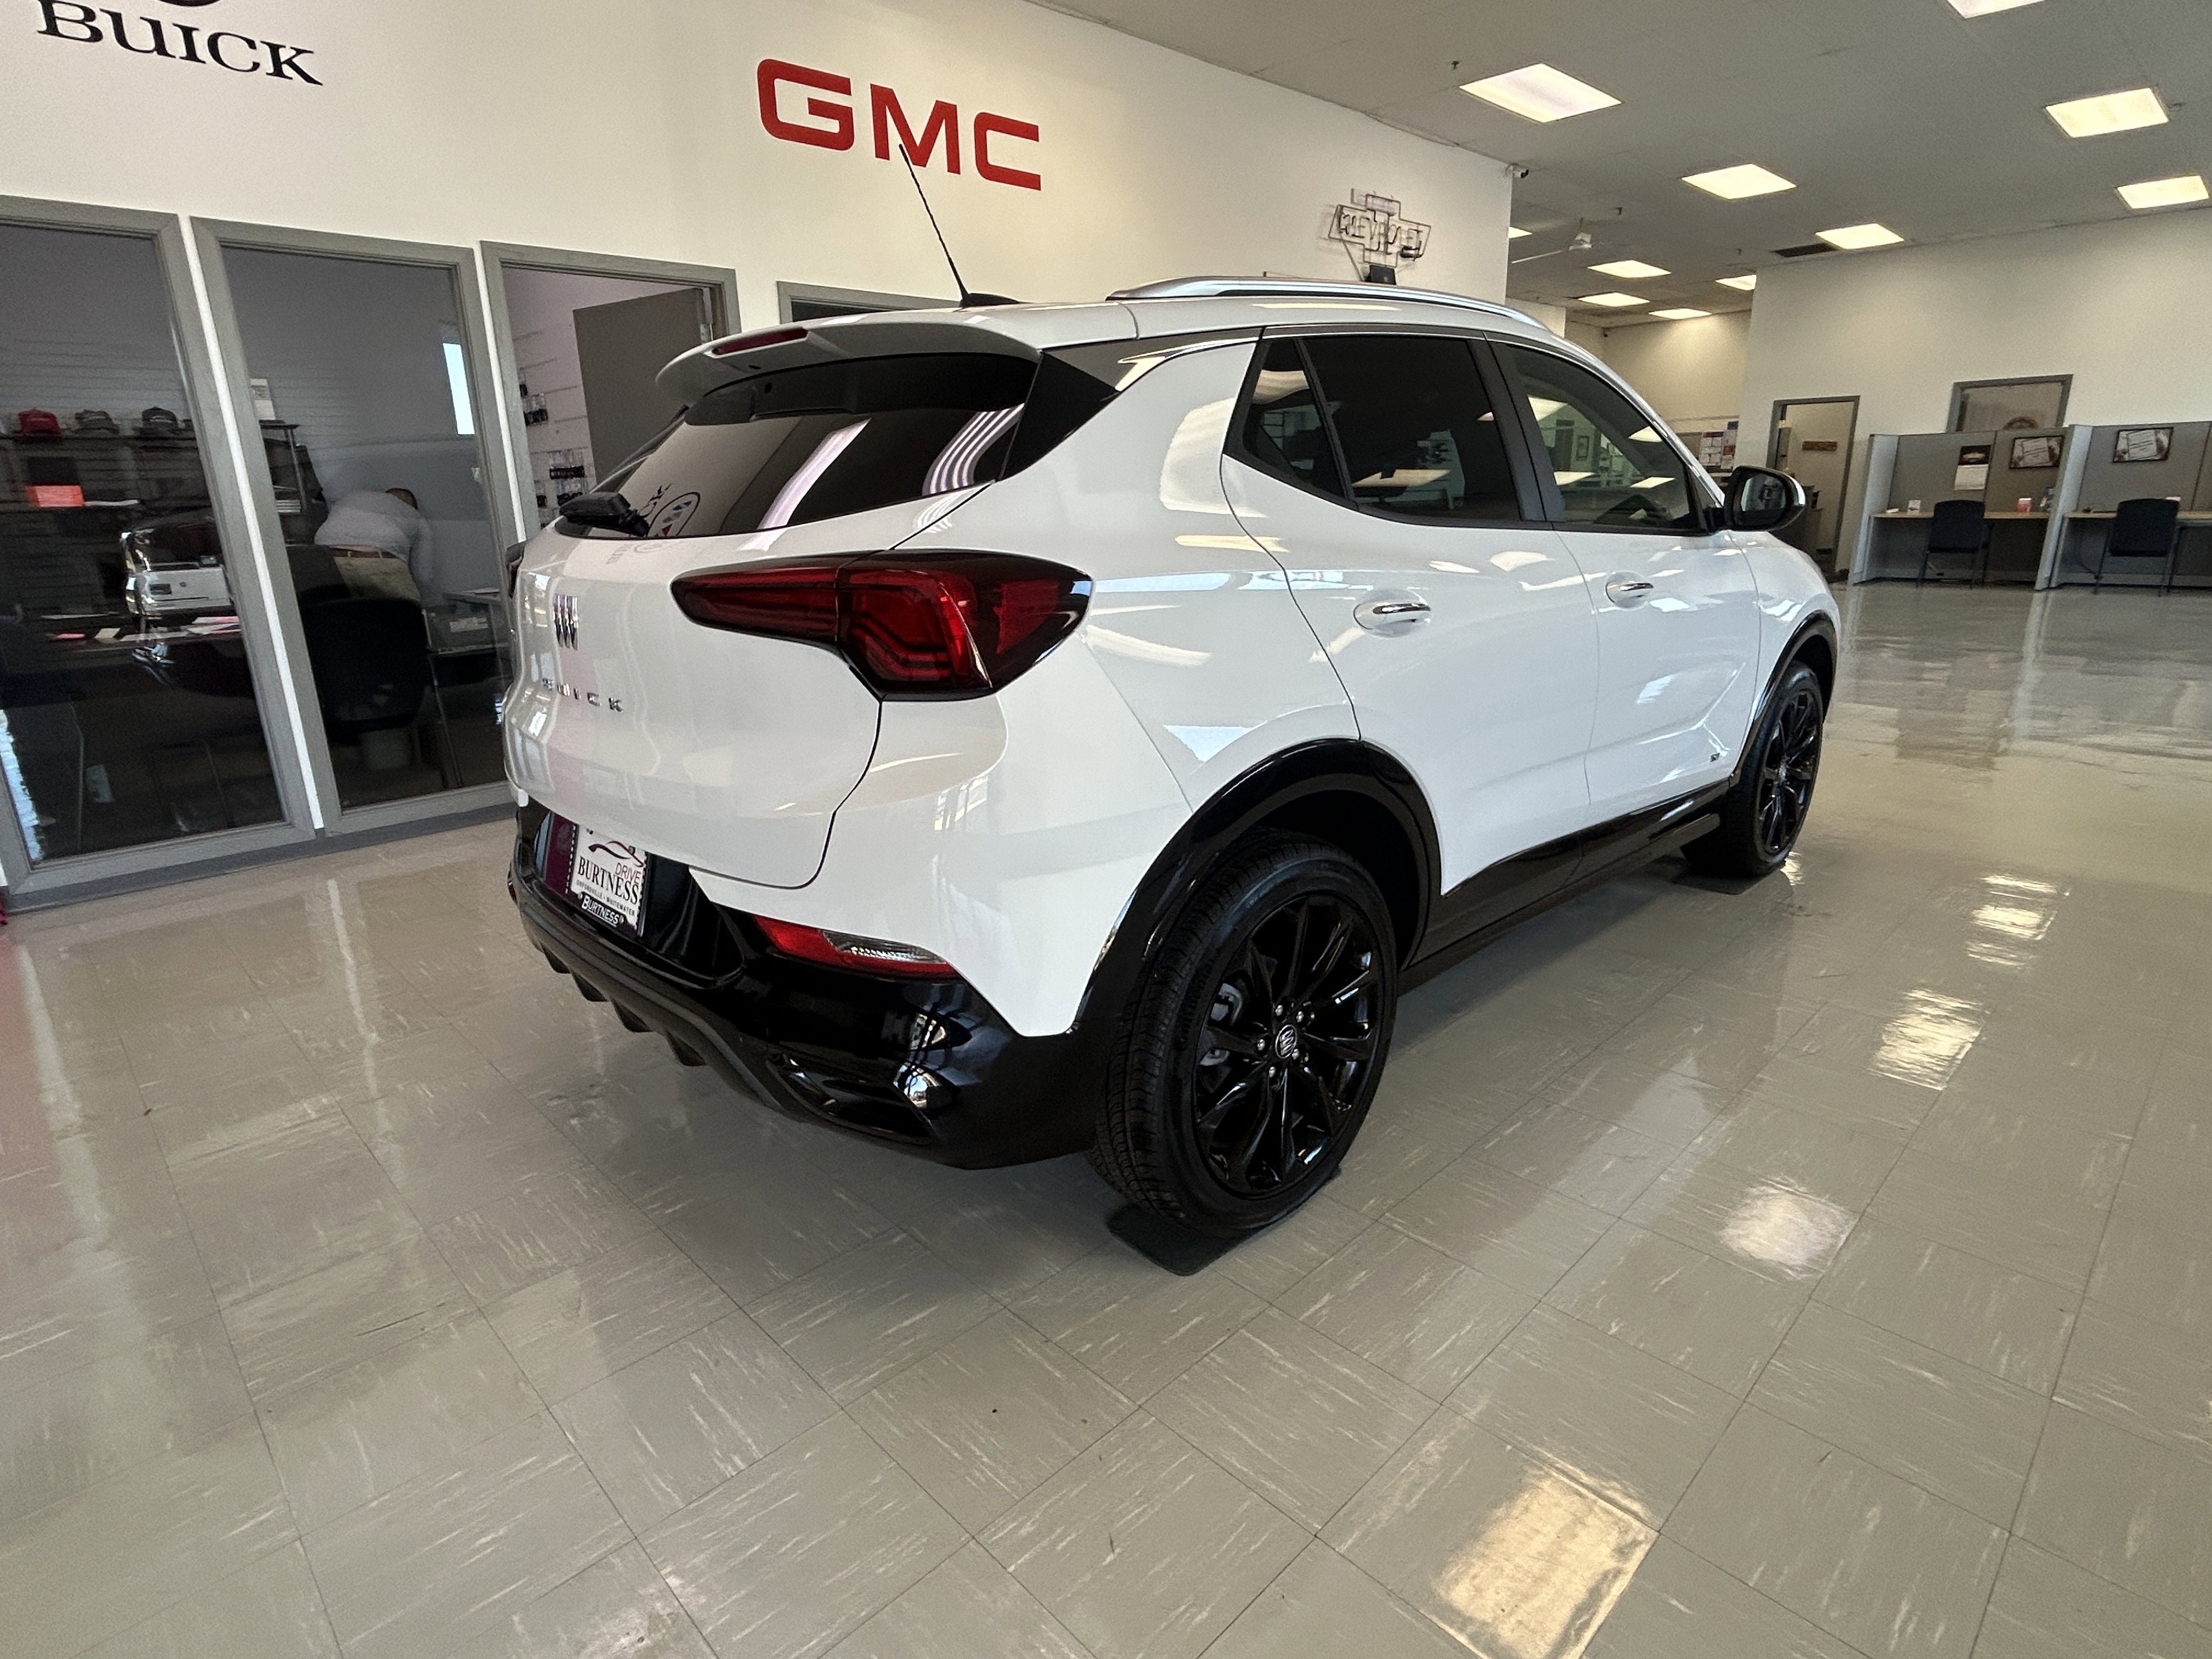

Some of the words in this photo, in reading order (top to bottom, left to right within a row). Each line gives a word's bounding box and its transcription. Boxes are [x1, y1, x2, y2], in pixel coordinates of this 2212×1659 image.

[37, 0, 323, 86] BUICK
[757, 58, 1041, 191] GMC
[542, 678, 623, 713] BUICK
[578, 855, 639, 905] BURTNESS
[615, 862, 641, 885] DRIVE
[581, 896, 619, 924] BURTNESS
